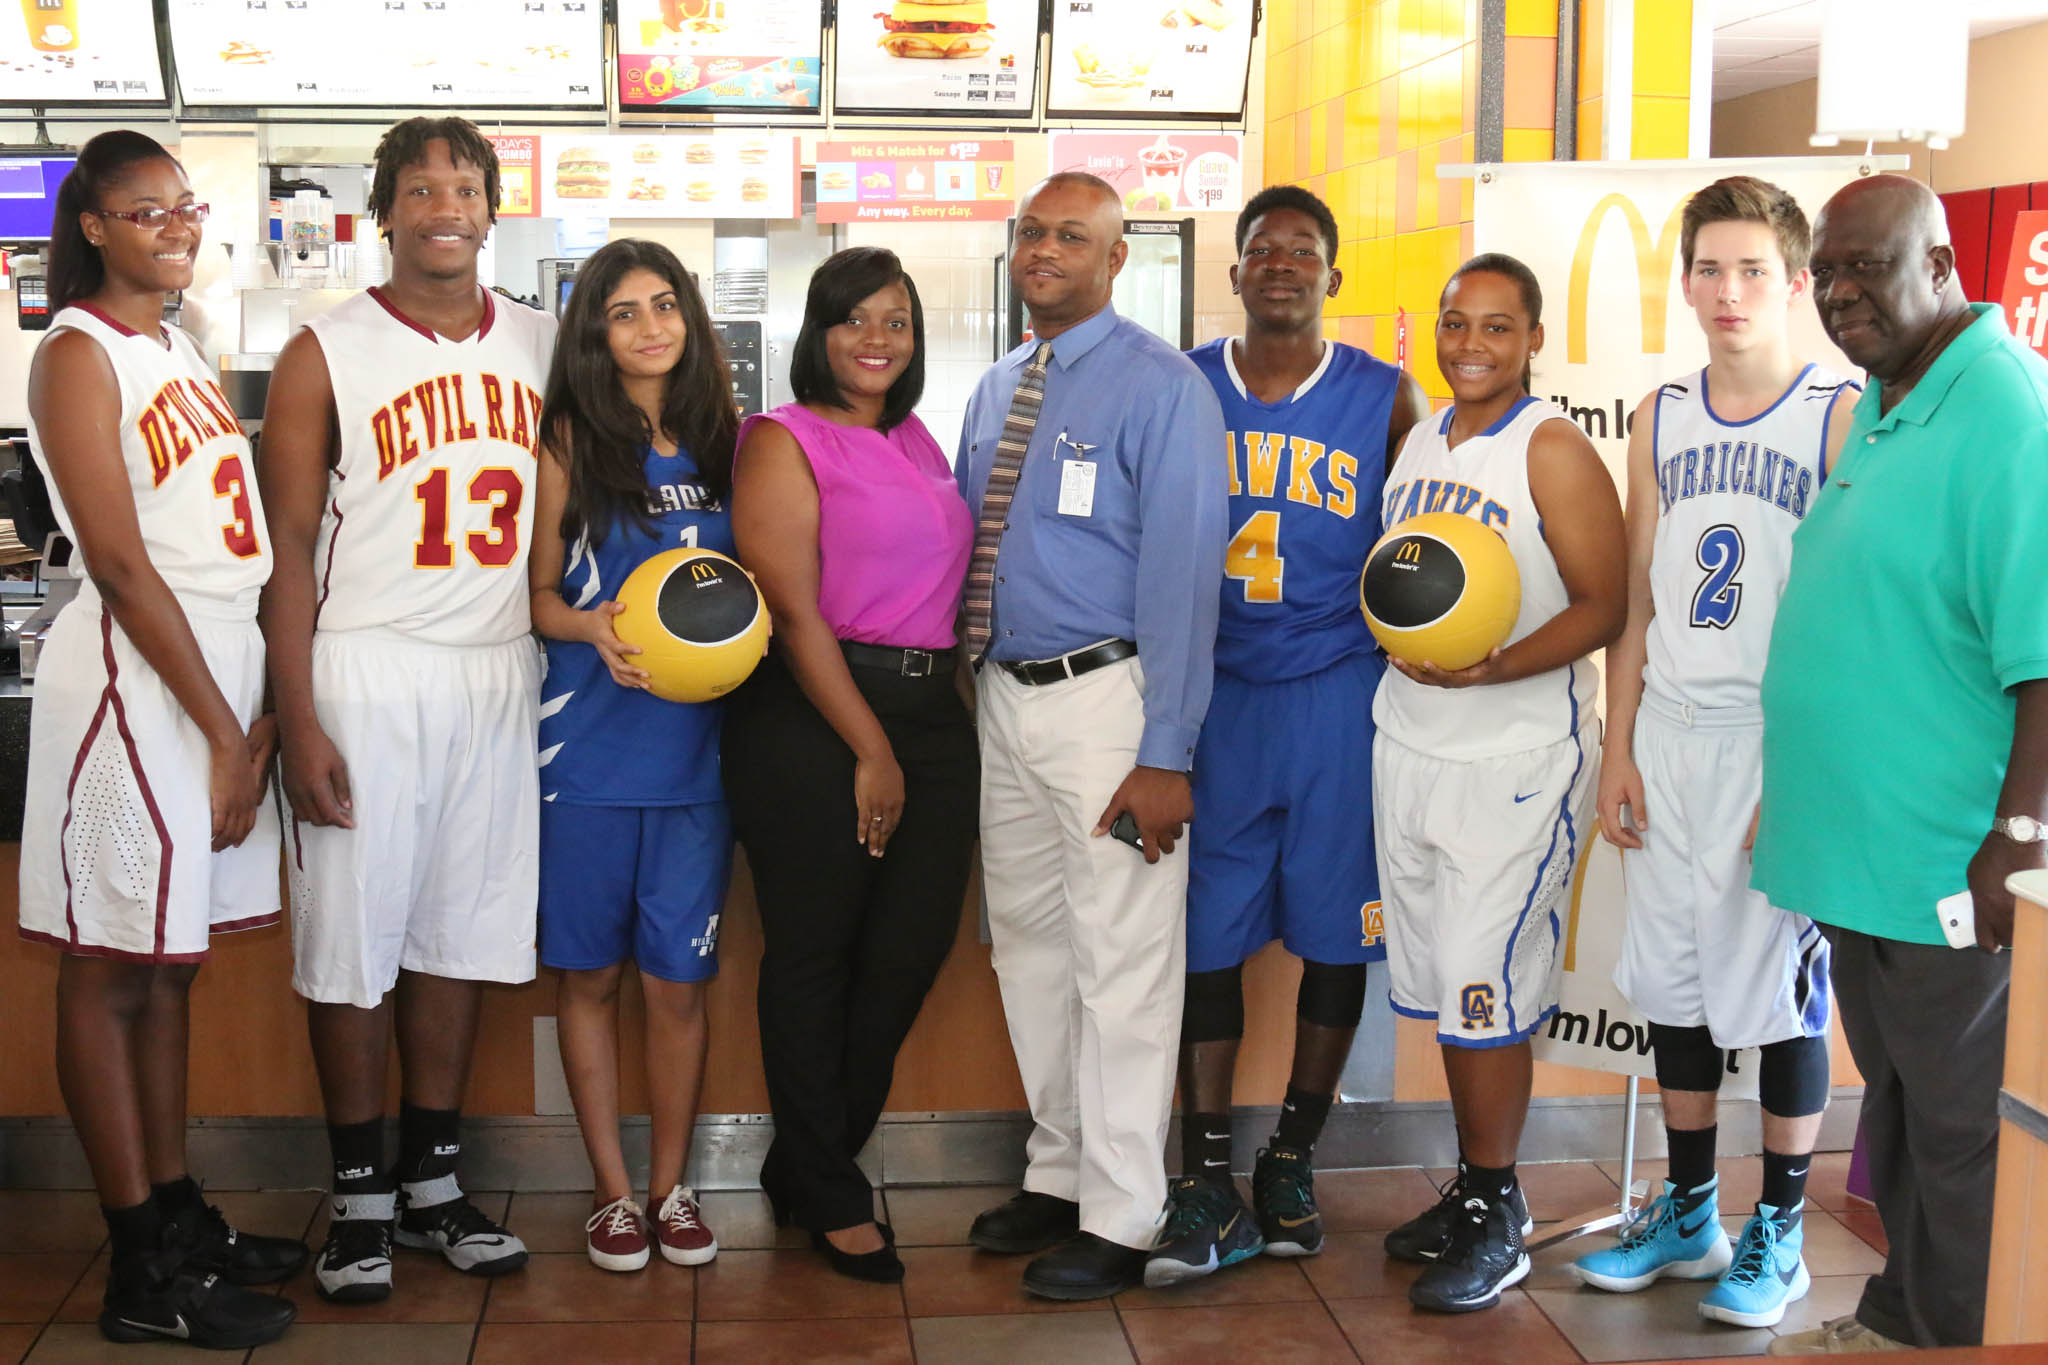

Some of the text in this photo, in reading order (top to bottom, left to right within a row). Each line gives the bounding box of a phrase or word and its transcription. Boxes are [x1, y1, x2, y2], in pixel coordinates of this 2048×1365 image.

[934, 91, 961, 99] Sausage
[851, 145, 874, 157] Mix
[888, 144, 926, 157] Match
[928, 143, 945, 157] for
[1199, 160, 1229, 174] Guava
[857, 205, 973, 219] Any way. Every day.
[370, 373, 479, 482] DEVIL
[211, 453, 262, 560] 3
[413, 467, 524, 569] 13
[680, 525, 698, 548] 1
[1224, 510, 1284, 603] 4
[1689, 524, 1745, 630] 2
